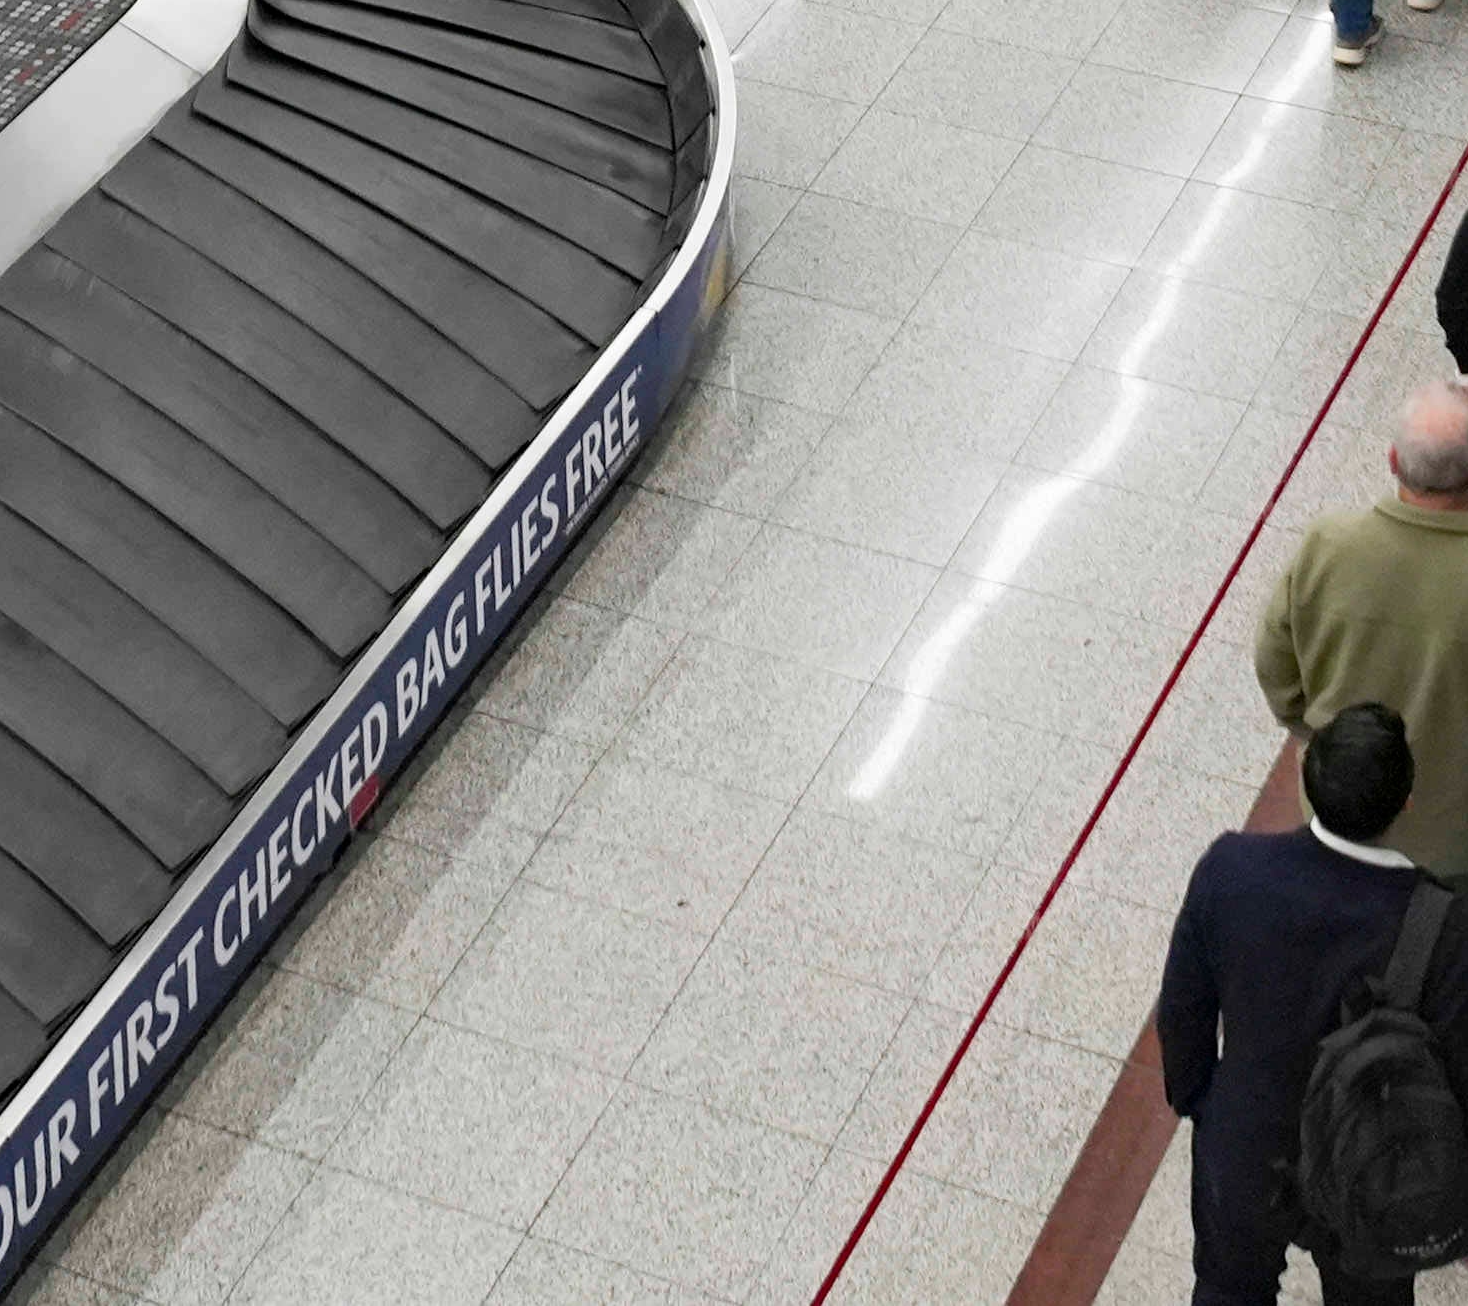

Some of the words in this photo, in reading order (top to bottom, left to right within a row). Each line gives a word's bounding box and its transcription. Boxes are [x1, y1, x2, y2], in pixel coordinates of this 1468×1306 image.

[87, 936, 203, 1138] FIRST
[212, 700, 389, 965] CHECKED
[393, 591, 468, 729] BAG
[474, 472, 560, 634] FLIES
